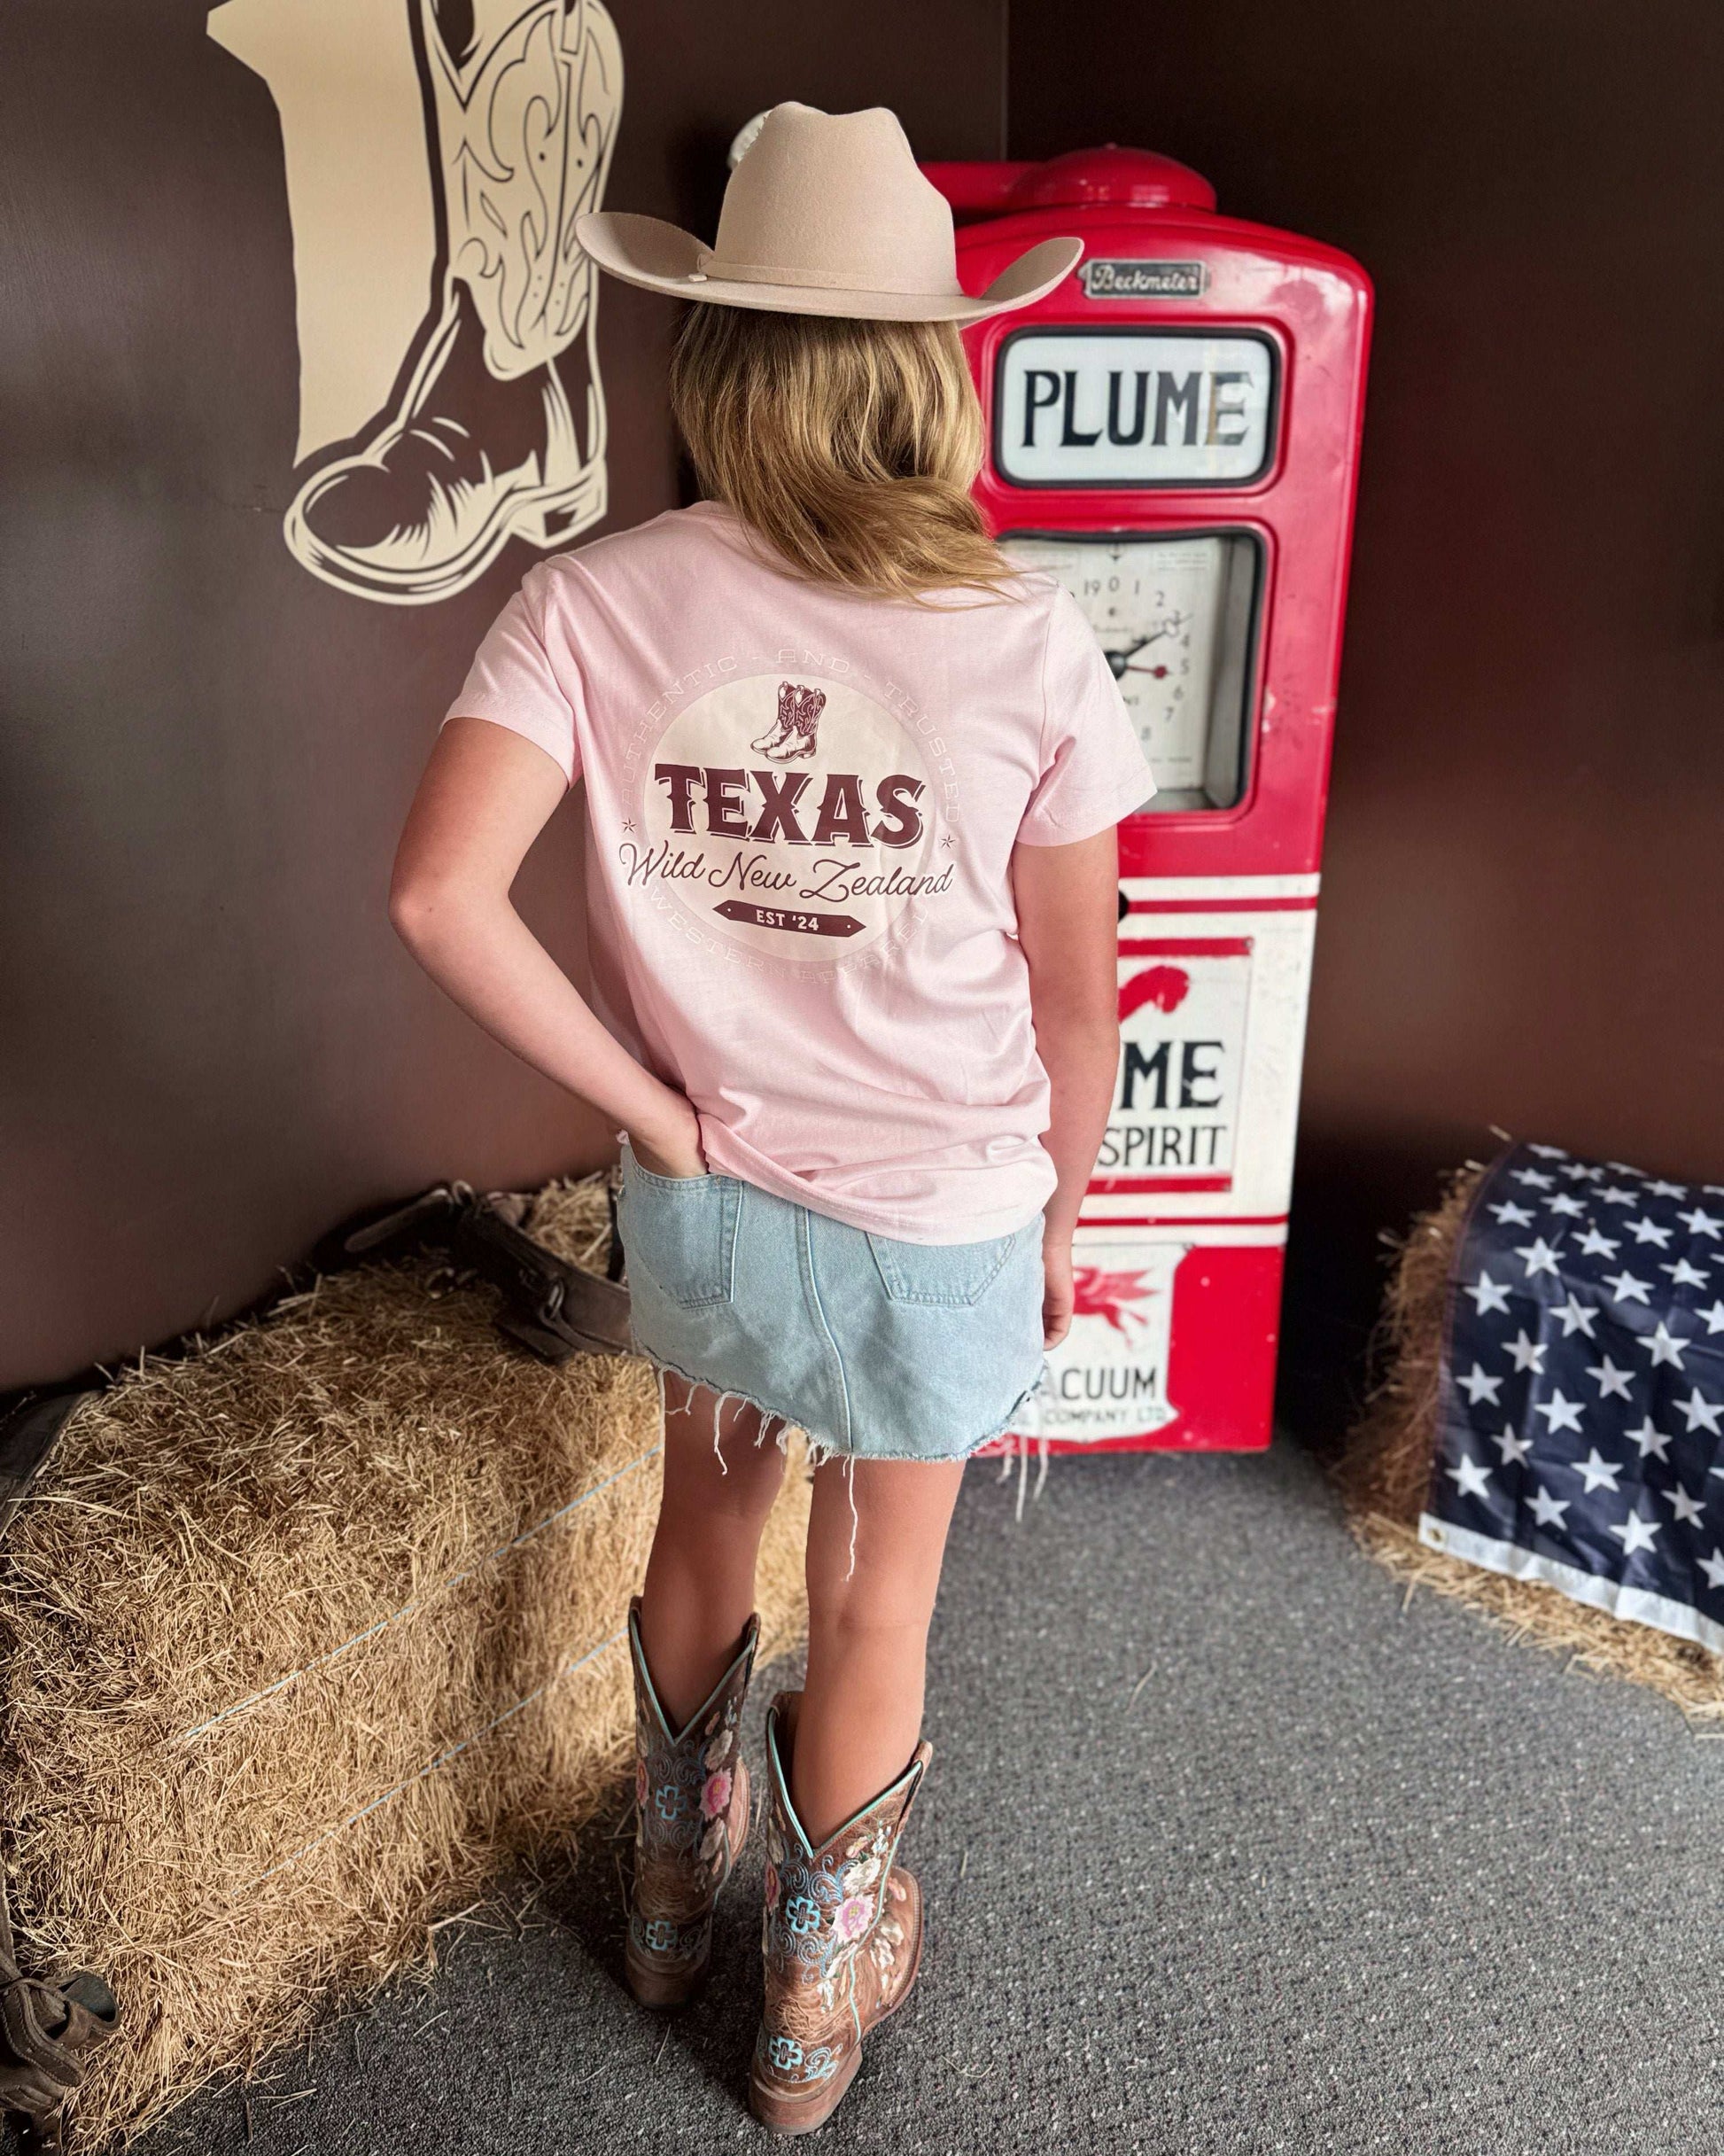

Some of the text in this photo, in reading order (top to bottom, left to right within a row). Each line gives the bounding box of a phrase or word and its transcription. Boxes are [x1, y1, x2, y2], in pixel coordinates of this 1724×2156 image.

[1091, 264, 1199, 291] Beckmeter
[1021, 370, 1254, 448] PLUME
[1083, 579, 1101, 596] 19
[1108, 577, 1120, 592] 0
[1154, 590, 1165, 607] 2
[1179, 633, 1190, 649] 4
[1180, 657, 1190, 675] 5
[1172, 683, 1184, 701] 6
[1165, 705, 1175, 722] 7
[620, 648, 961, 822] AUTHENTIC AND TRUSTED
[654, 763, 926, 849] TEXAS
[618, 839, 954, 903] Wild New Zealand
[649, 885, 787, 978] WESTERN
[756, 909, 819, 930] EST '24
[1118, 1040, 1226, 1110] ME
[1097, 1125, 1228, 1167] SPIRIT
